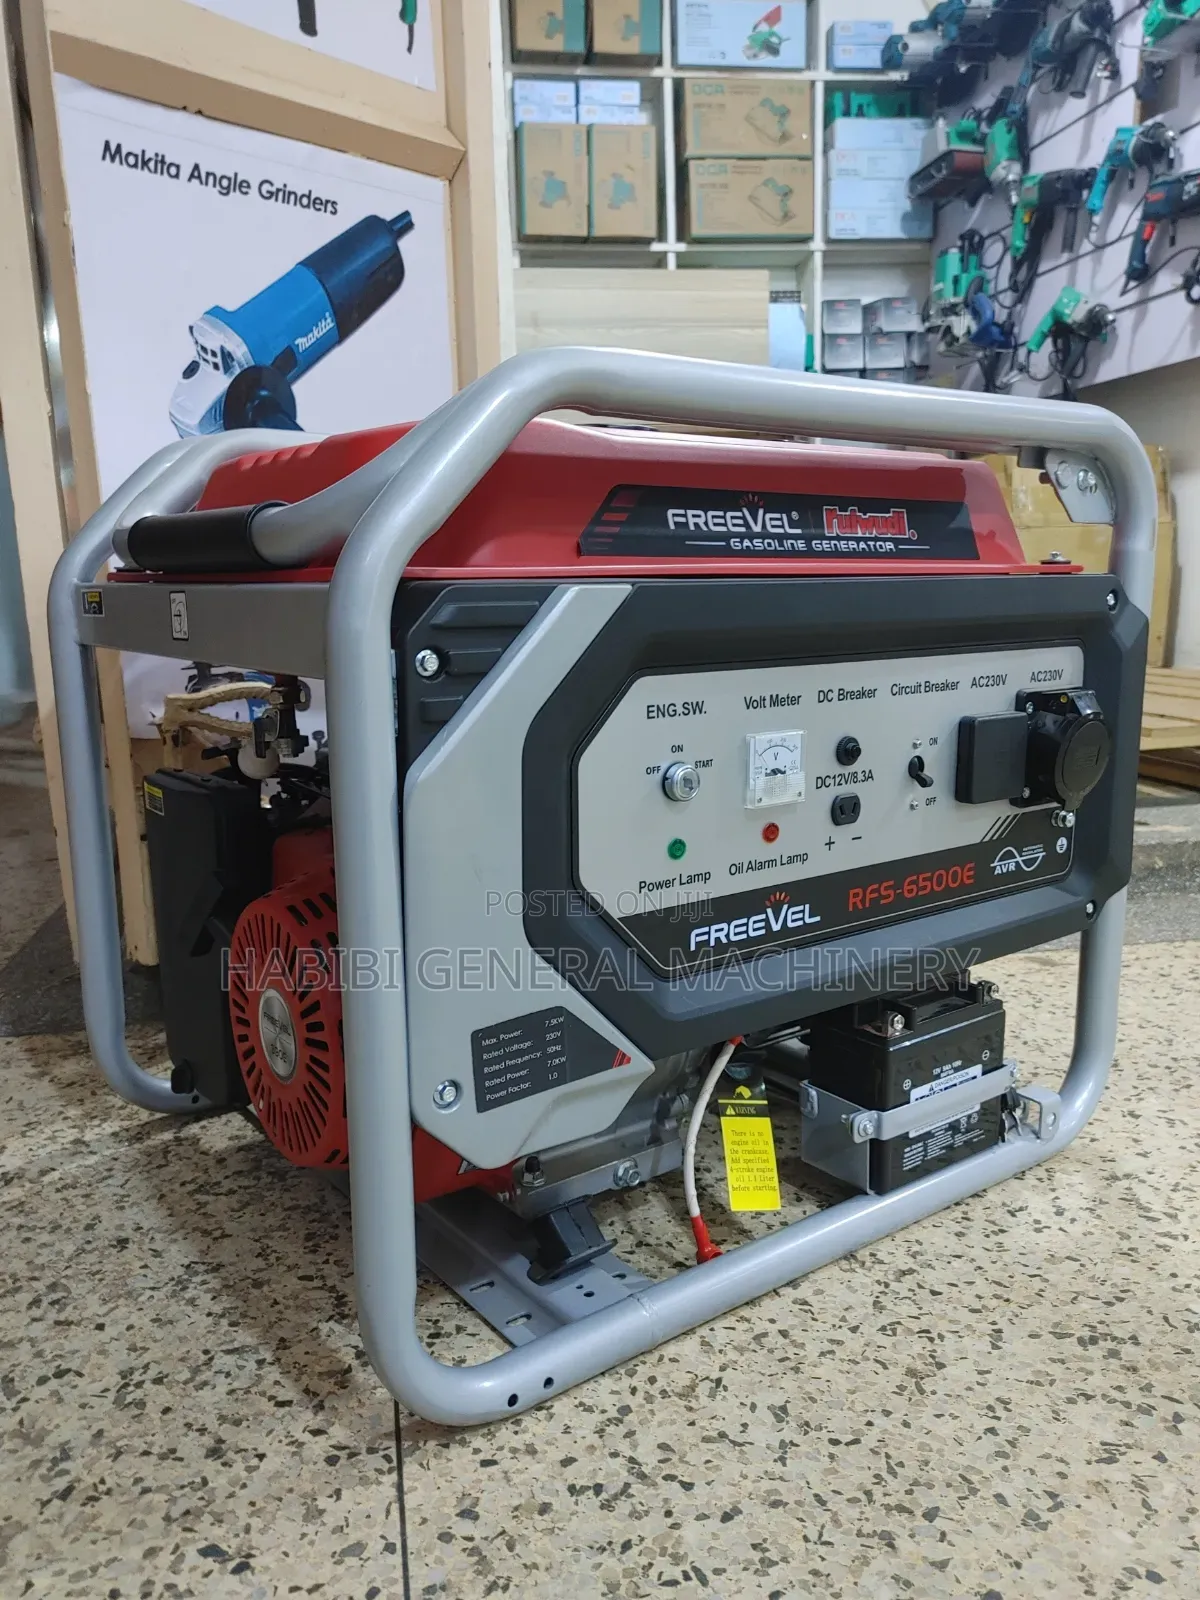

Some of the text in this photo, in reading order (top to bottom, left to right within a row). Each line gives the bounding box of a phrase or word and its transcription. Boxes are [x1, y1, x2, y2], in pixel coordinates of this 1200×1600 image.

[101, 139, 339, 216] Makita Angle Grinders
[729, 538, 896, 553] GASOLINE GENERATOR
[970, 673, 1008, 689] AC230V
[1029, 668, 1064, 683] AC230V
[817, 686, 878, 704] DC Breaker
[890, 679, 960, 697] Circuit Breaker
[743, 692, 802, 711] Volt Meter
[646, 700, 708, 720] ENG.SW.
[670, 744, 684, 754] ON
[928, 736, 939, 746] ON
[645, 765, 661, 775] OFF
[694, 758, 714, 770] START
[815, 769, 875, 790] DC12V/8.3A
[925, 797, 937, 807] OFF
[728, 851, 809, 877] Oil Alarm Lamp
[993, 862, 1016, 876] AVR
[638, 869, 711, 895] Power Lamp
[848, 862, 976, 912] RFS-6500E
[482, 1015, 565, 1047] Max. Power: 7.5KW
[483, 1030, 562, 1061] Rated Voltage: 230V
[484, 1044, 562, 1075] Rated Frequency: 50Hz
[485, 1055, 567, 1088] Rated Power: 7.0KW
[486, 1071, 558, 1102] Power Factor: 1.0
[731, 1129, 746, 1137] There
[749, 1129, 755, 1137] is
[731, 1138, 749, 1147] engine
[730, 1147, 739, 1155] the
[742, 1156, 770, 1165] specified
[756, 1165, 774, 1174] engine
[731, 1184, 750, 1192] before
